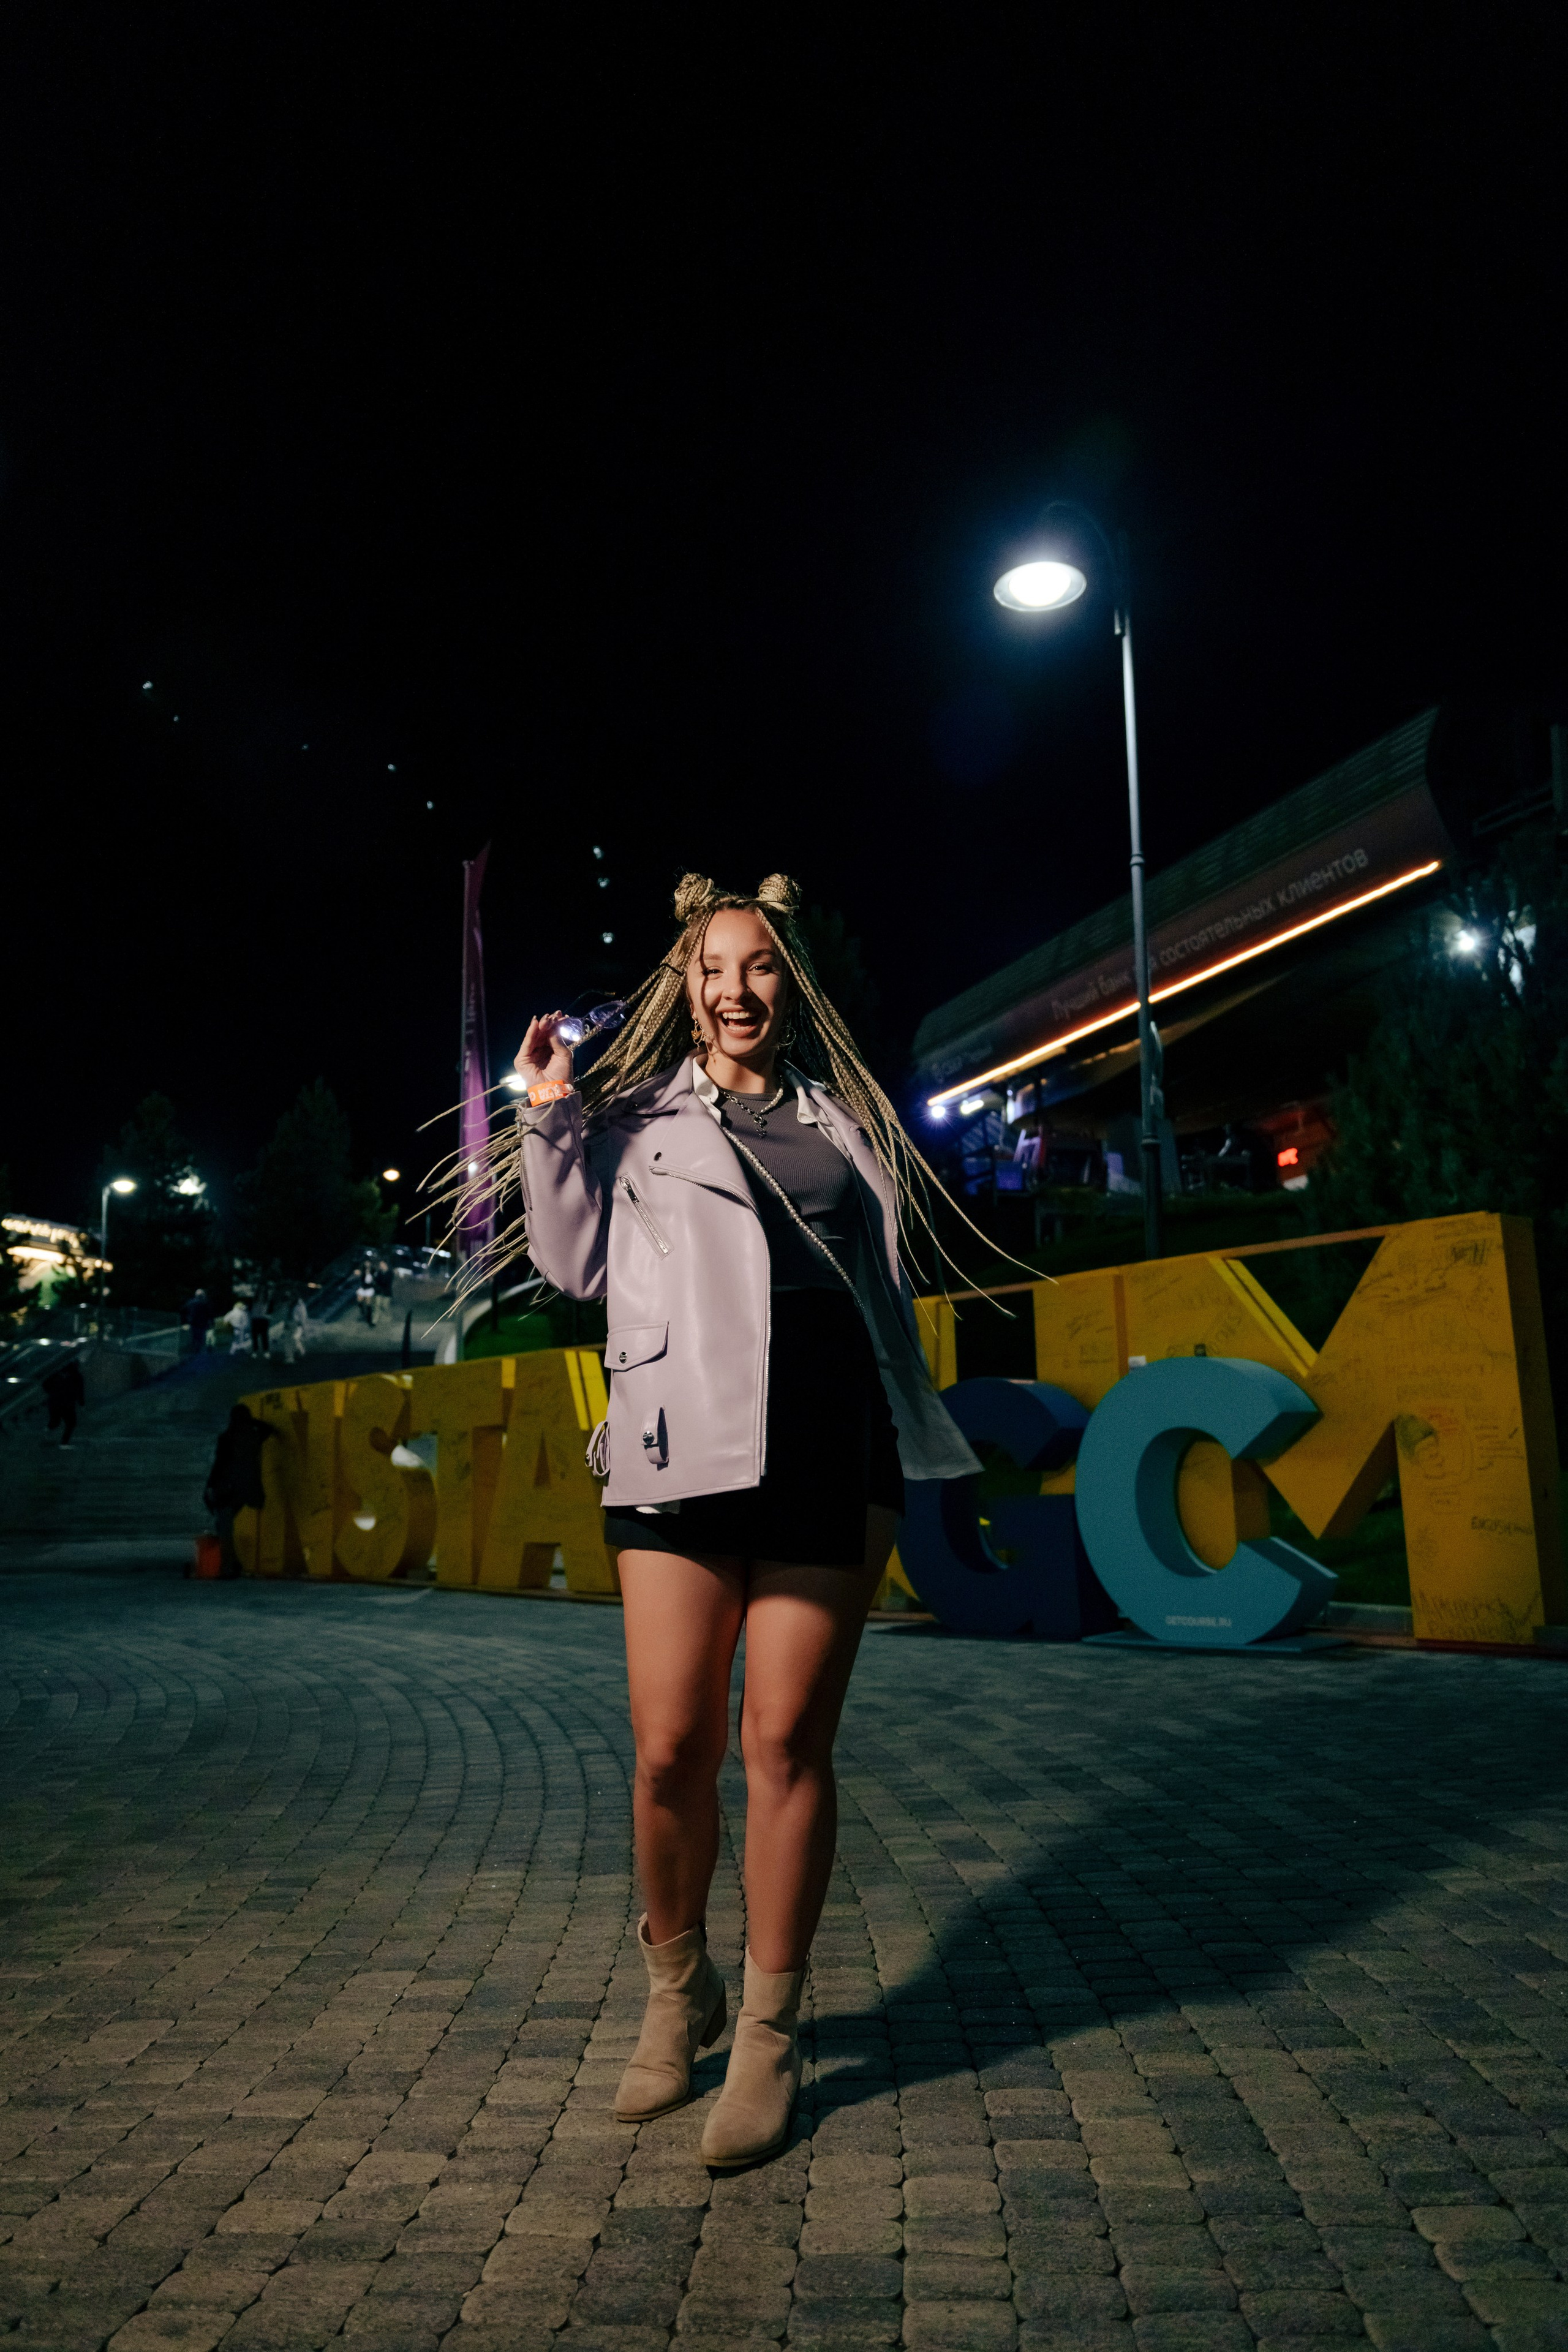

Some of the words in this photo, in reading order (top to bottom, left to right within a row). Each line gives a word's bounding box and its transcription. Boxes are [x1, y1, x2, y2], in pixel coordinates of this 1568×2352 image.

[1097, 973, 1132, 997] банк
[1159, 898, 1277, 967] состоятельных
[1277, 847, 1370, 907] клиентов
